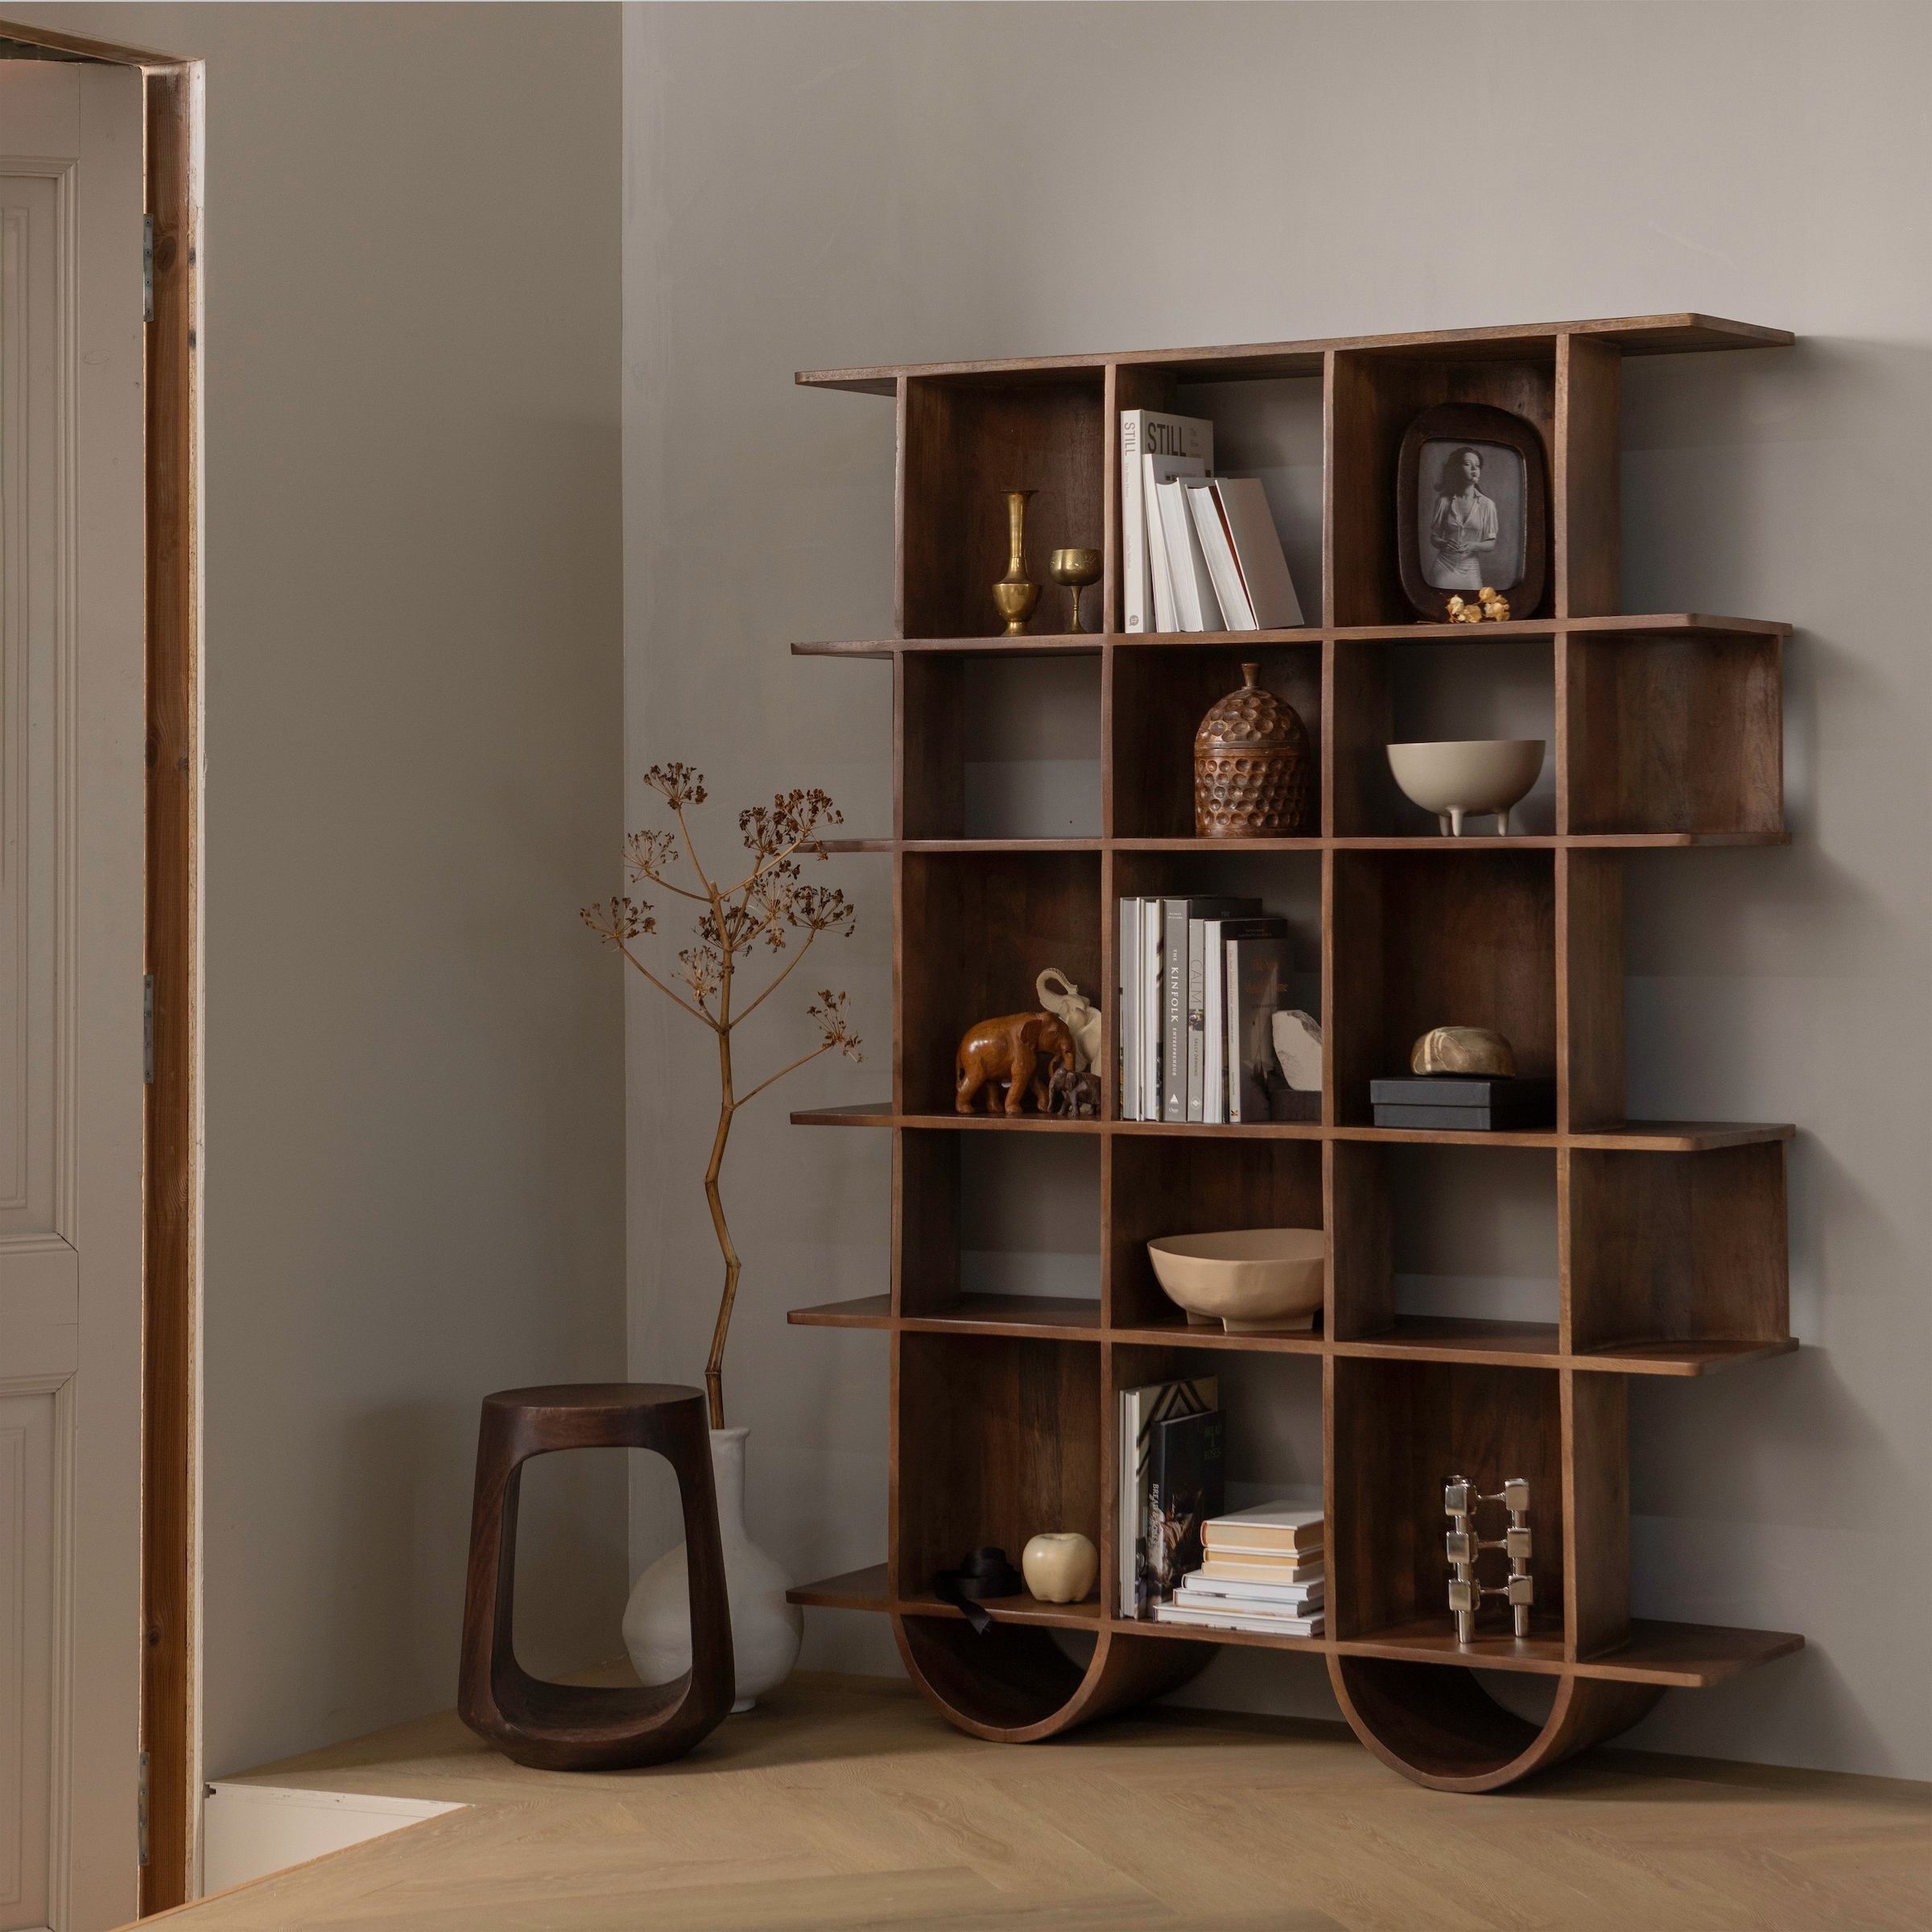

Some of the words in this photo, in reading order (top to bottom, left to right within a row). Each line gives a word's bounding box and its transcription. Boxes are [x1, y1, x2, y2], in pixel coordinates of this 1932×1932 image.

[1125, 422, 1136, 456] STILL
[1147, 422, 1187, 456] STILL
[1170, 967, 1179, 1022] KINFOLK
[1191, 960, 1202, 1003] CALM
[1151, 1520, 1159, 1546] ROSES
